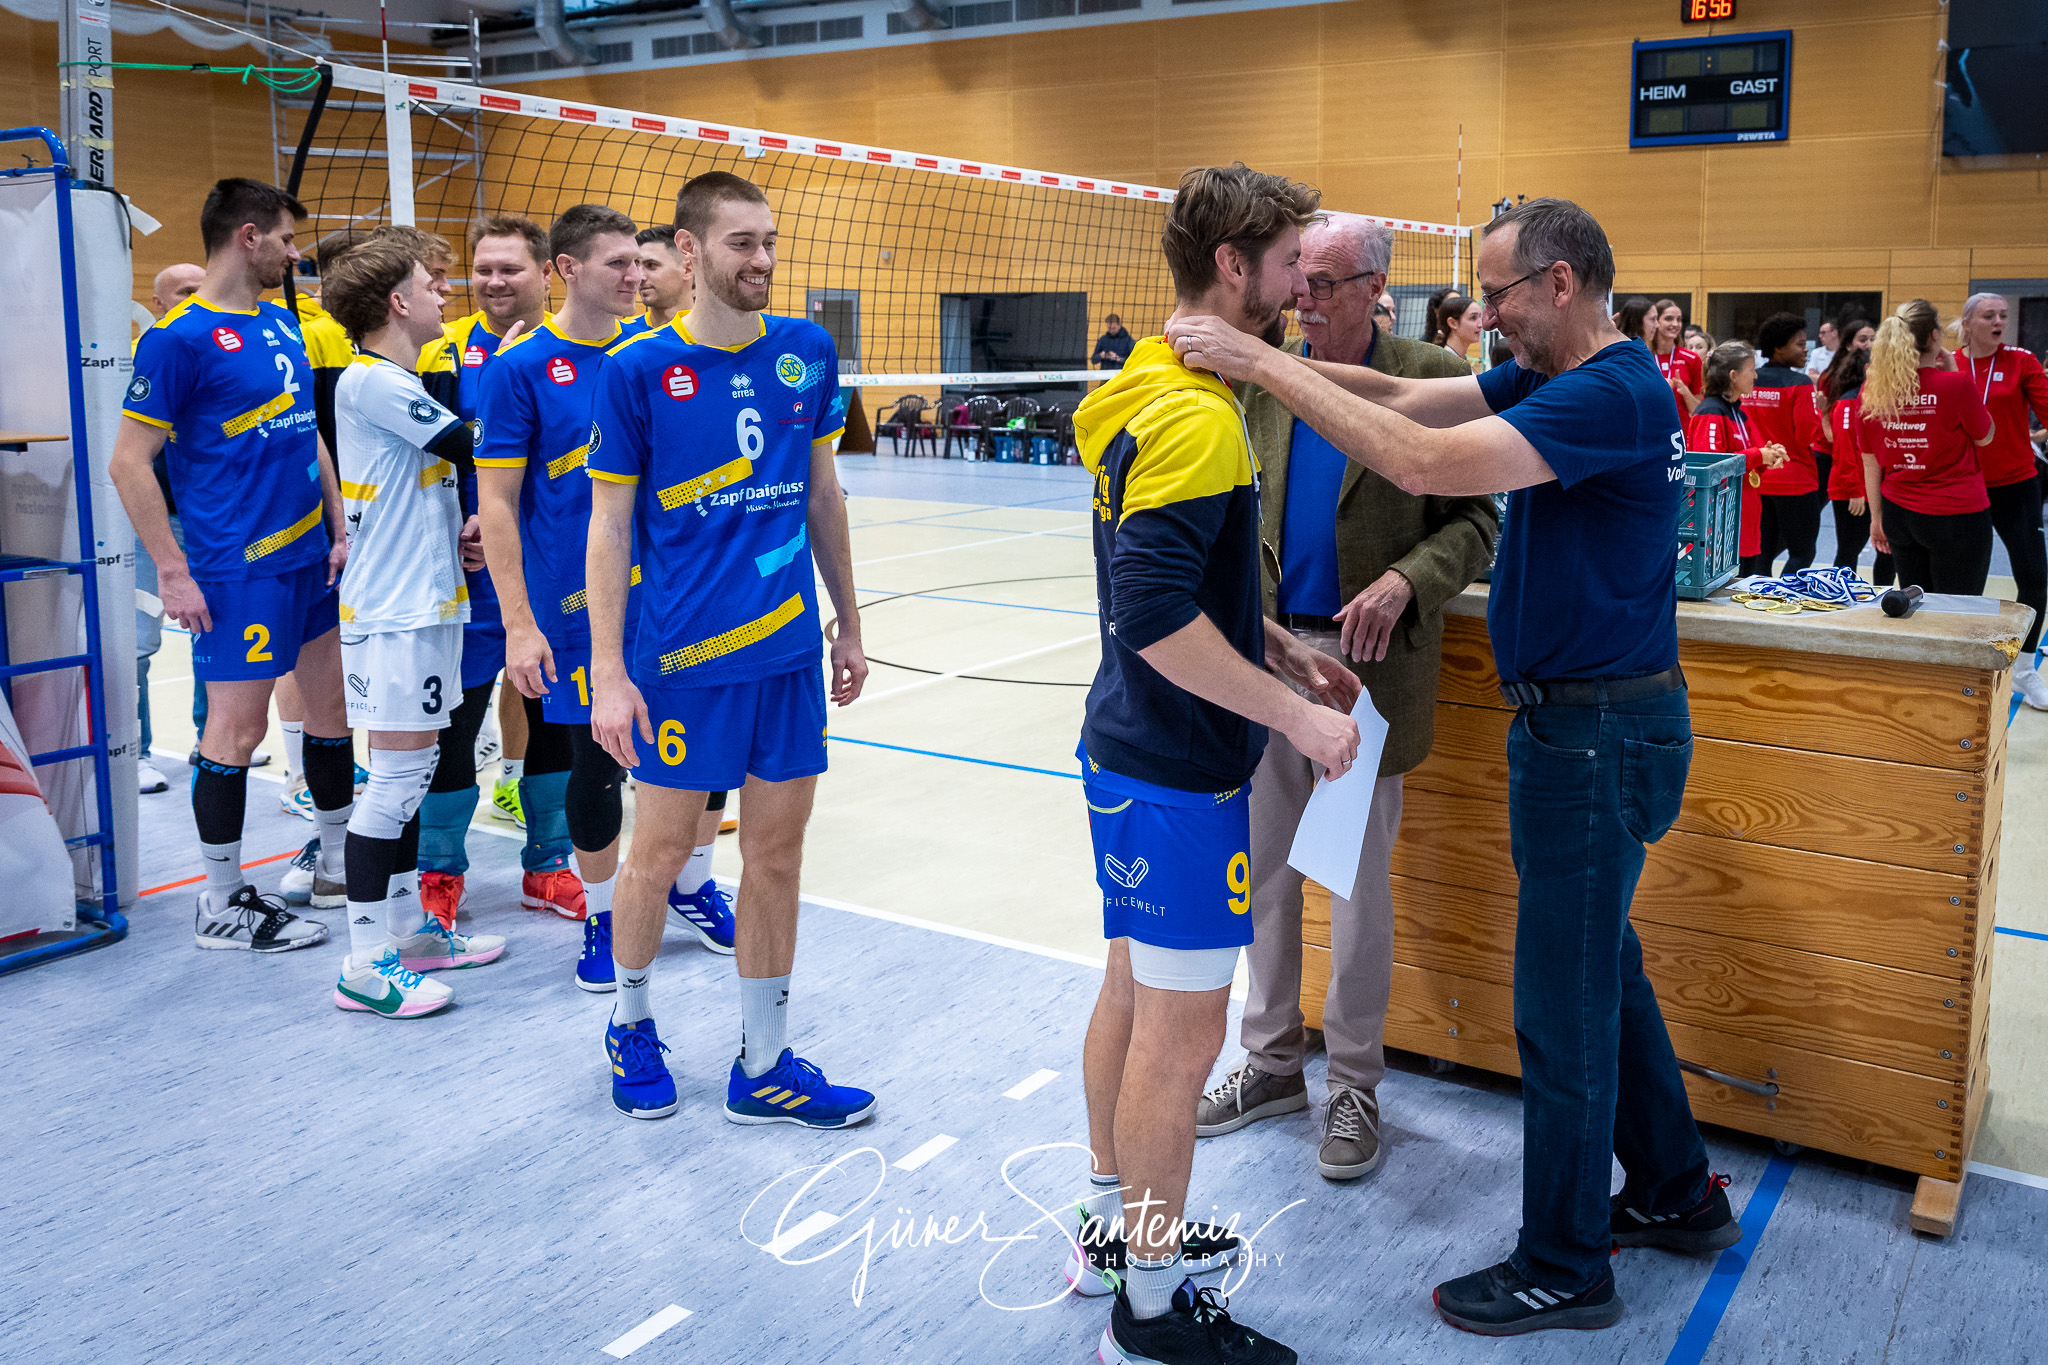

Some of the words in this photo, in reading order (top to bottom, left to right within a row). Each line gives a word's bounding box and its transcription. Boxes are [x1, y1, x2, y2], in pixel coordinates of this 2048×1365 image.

[88, 37, 102, 77] PORT
[1640, 84, 1686, 101] HEIM
[1730, 78, 1778, 95] GAST
[81, 357, 115, 369] Zapf
[275, 353, 300, 394] 2
[732, 388, 755, 399] errea
[269, 413, 294, 429] Zapf
[1887, 421, 1927, 432] Flottweg
[736, 408, 764, 460] 6
[710, 488, 746, 507] Zapf
[746, 481, 804, 500] Daigfuss
[97, 554, 121, 566] apf
[243, 624, 273, 663] 2
[422, 675, 443, 715] 3
[571, 666, 594, 706] 1
[310, 738, 350, 747] cep
[658, 719, 687, 766] 6
[200, 760, 241, 776] cep
[1226, 851, 1250, 915] 9
[1104, 896, 1166, 917] FICEWELT
